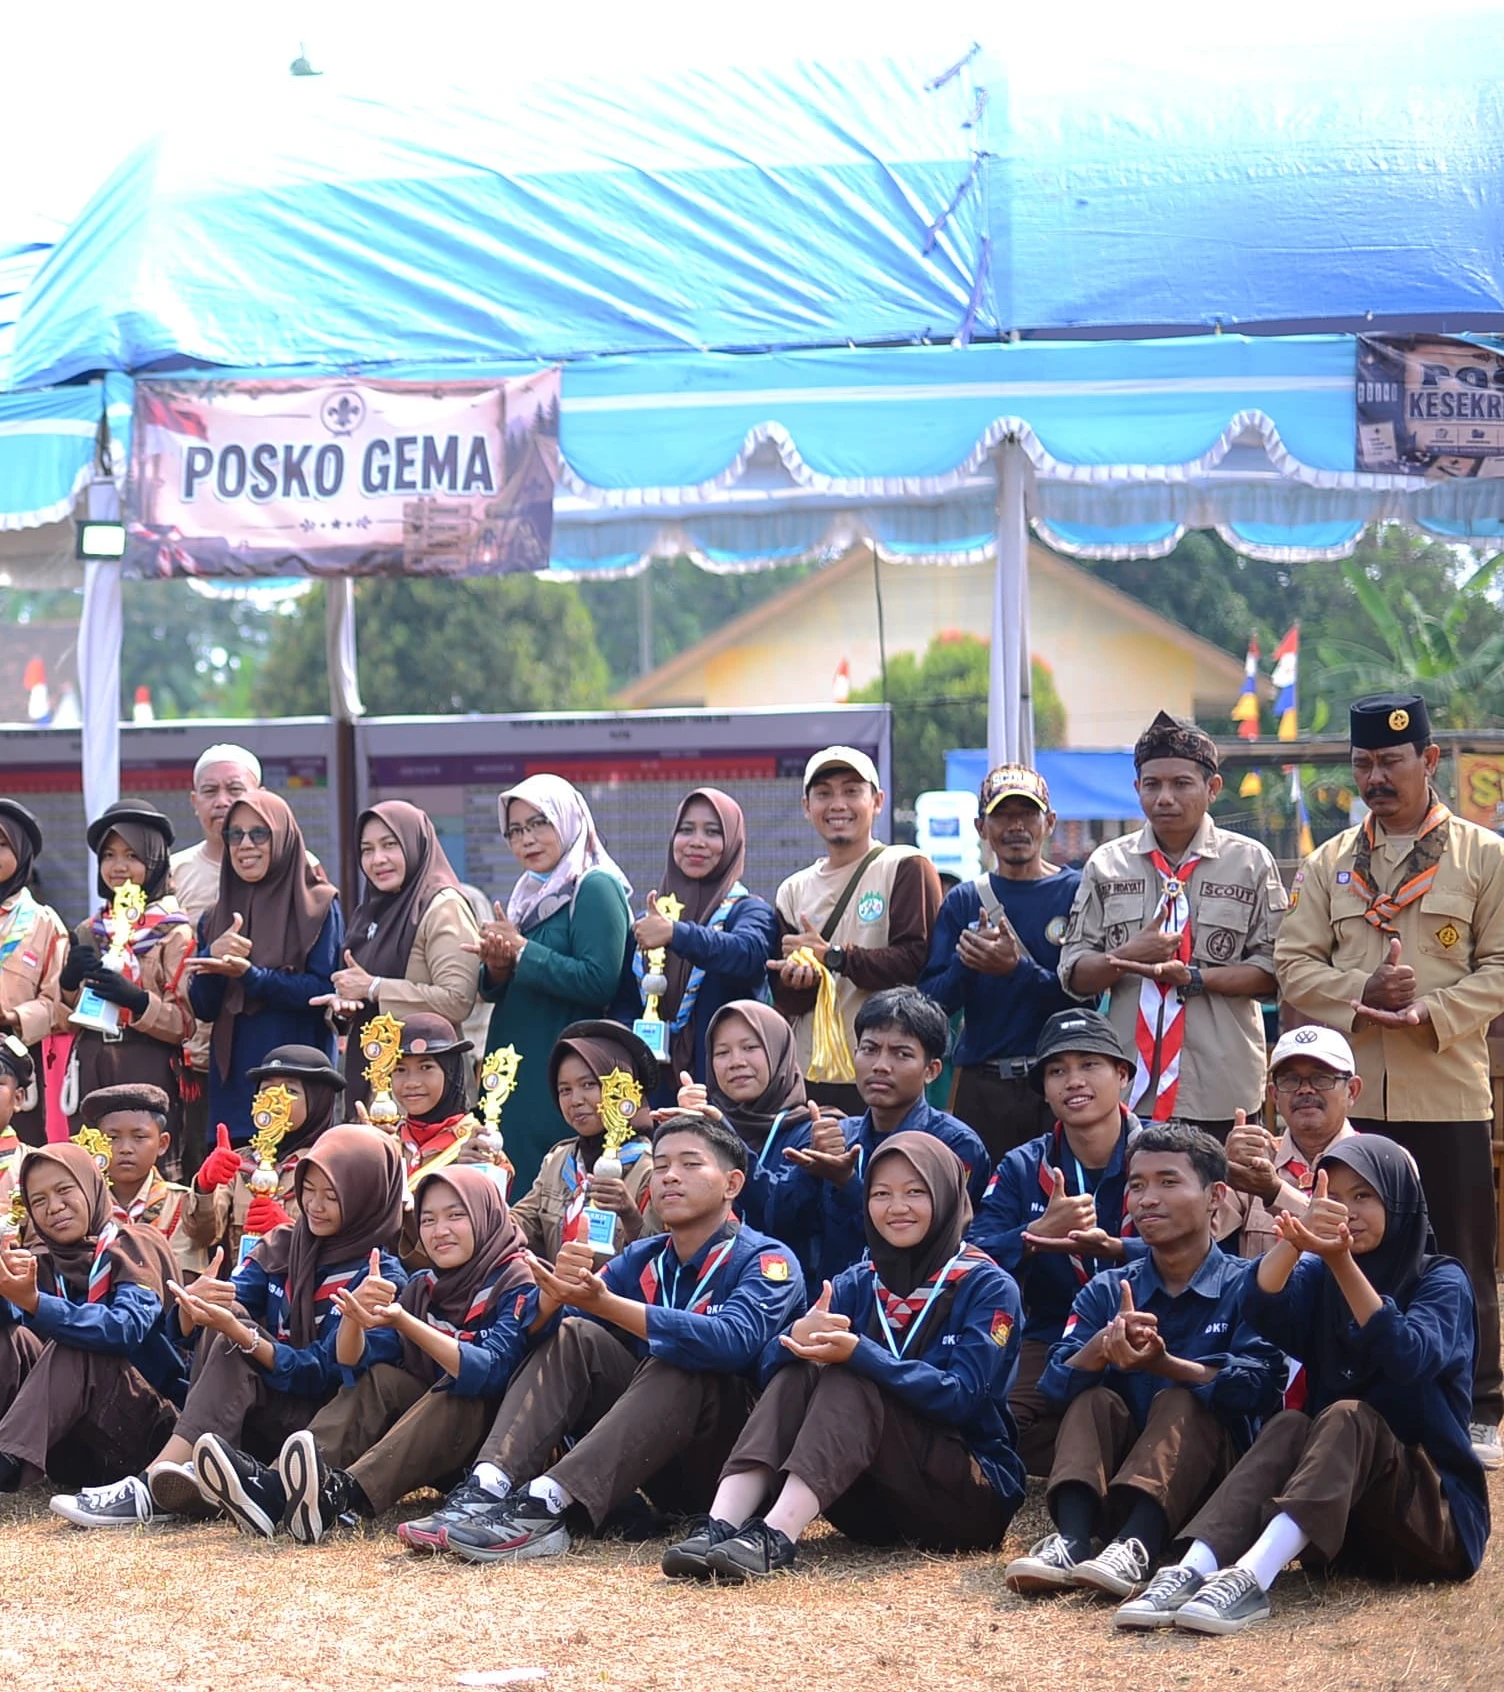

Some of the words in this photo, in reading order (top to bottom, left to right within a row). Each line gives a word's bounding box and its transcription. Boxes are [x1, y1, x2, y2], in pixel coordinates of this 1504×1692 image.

[1409, 391, 1504, 418] KESEKR
[183, 443, 345, 499] POSKO
[362, 435, 494, 494] GEMA
[1204, 884, 1254, 902] SCOUT
